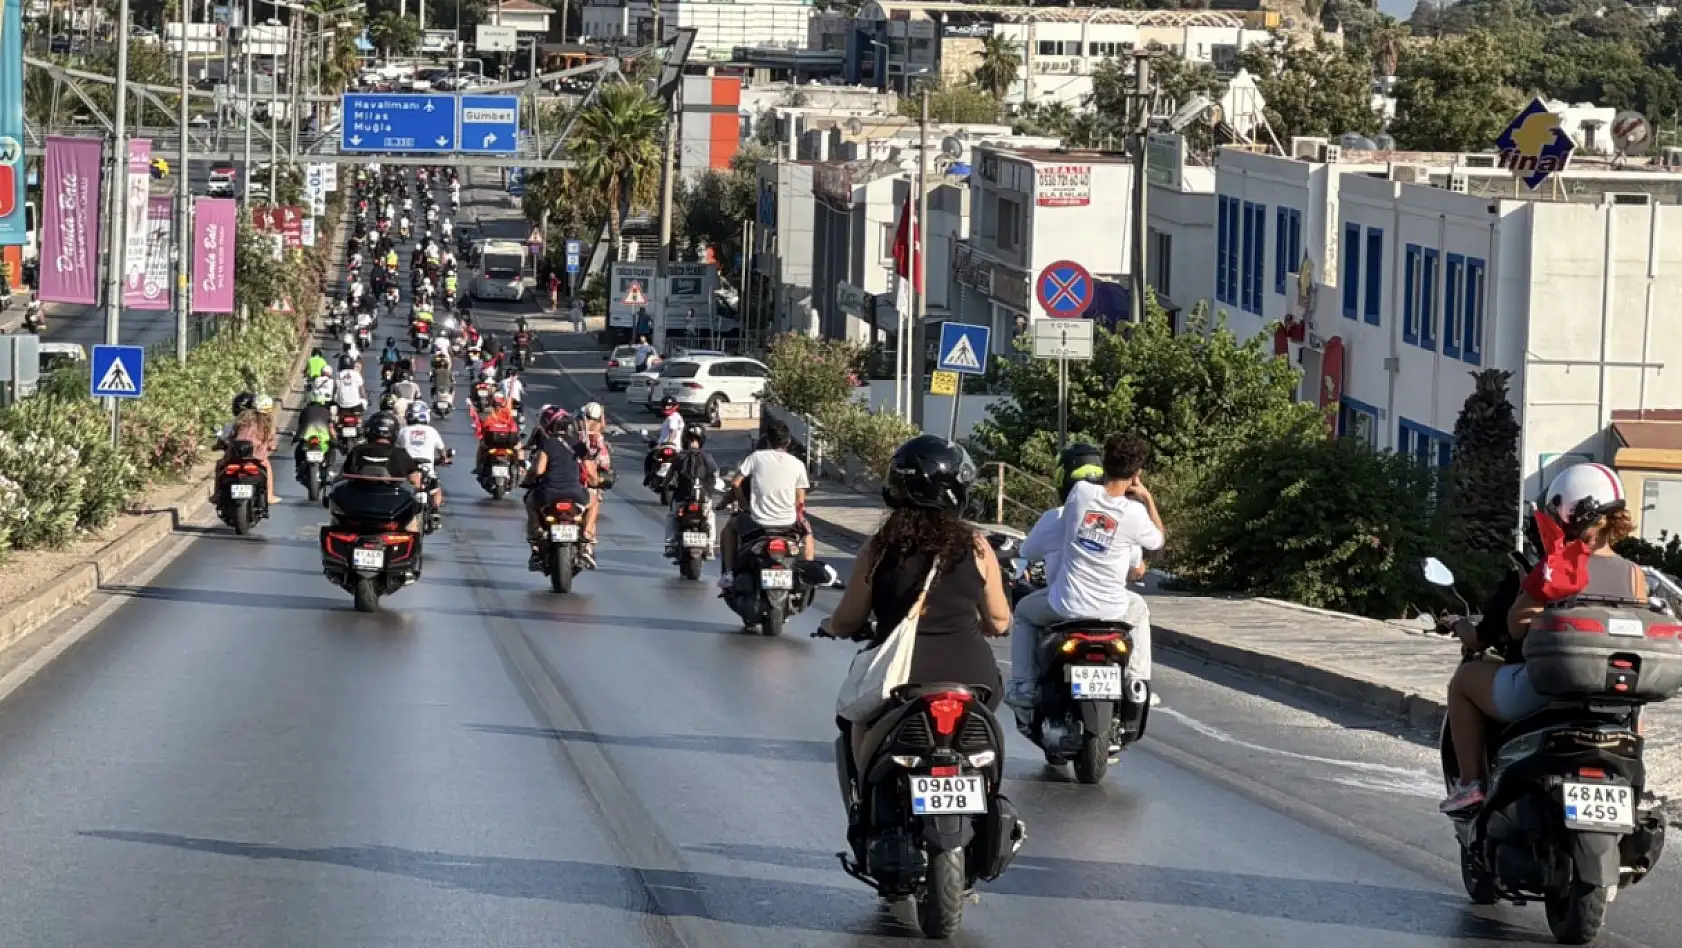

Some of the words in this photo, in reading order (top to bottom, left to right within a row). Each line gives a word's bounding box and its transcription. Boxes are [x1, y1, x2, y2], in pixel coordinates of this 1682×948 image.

[354, 111, 389, 120] Milas
[354, 122, 392, 134] Muğla
[1497, 148, 1569, 173] final
[1074, 669, 1088, 679] 48
[1093, 669, 1118, 680] AVH
[1089, 682, 1111, 692] 874
[930, 795, 967, 808] 878
[1582, 804, 1617, 820] 459
